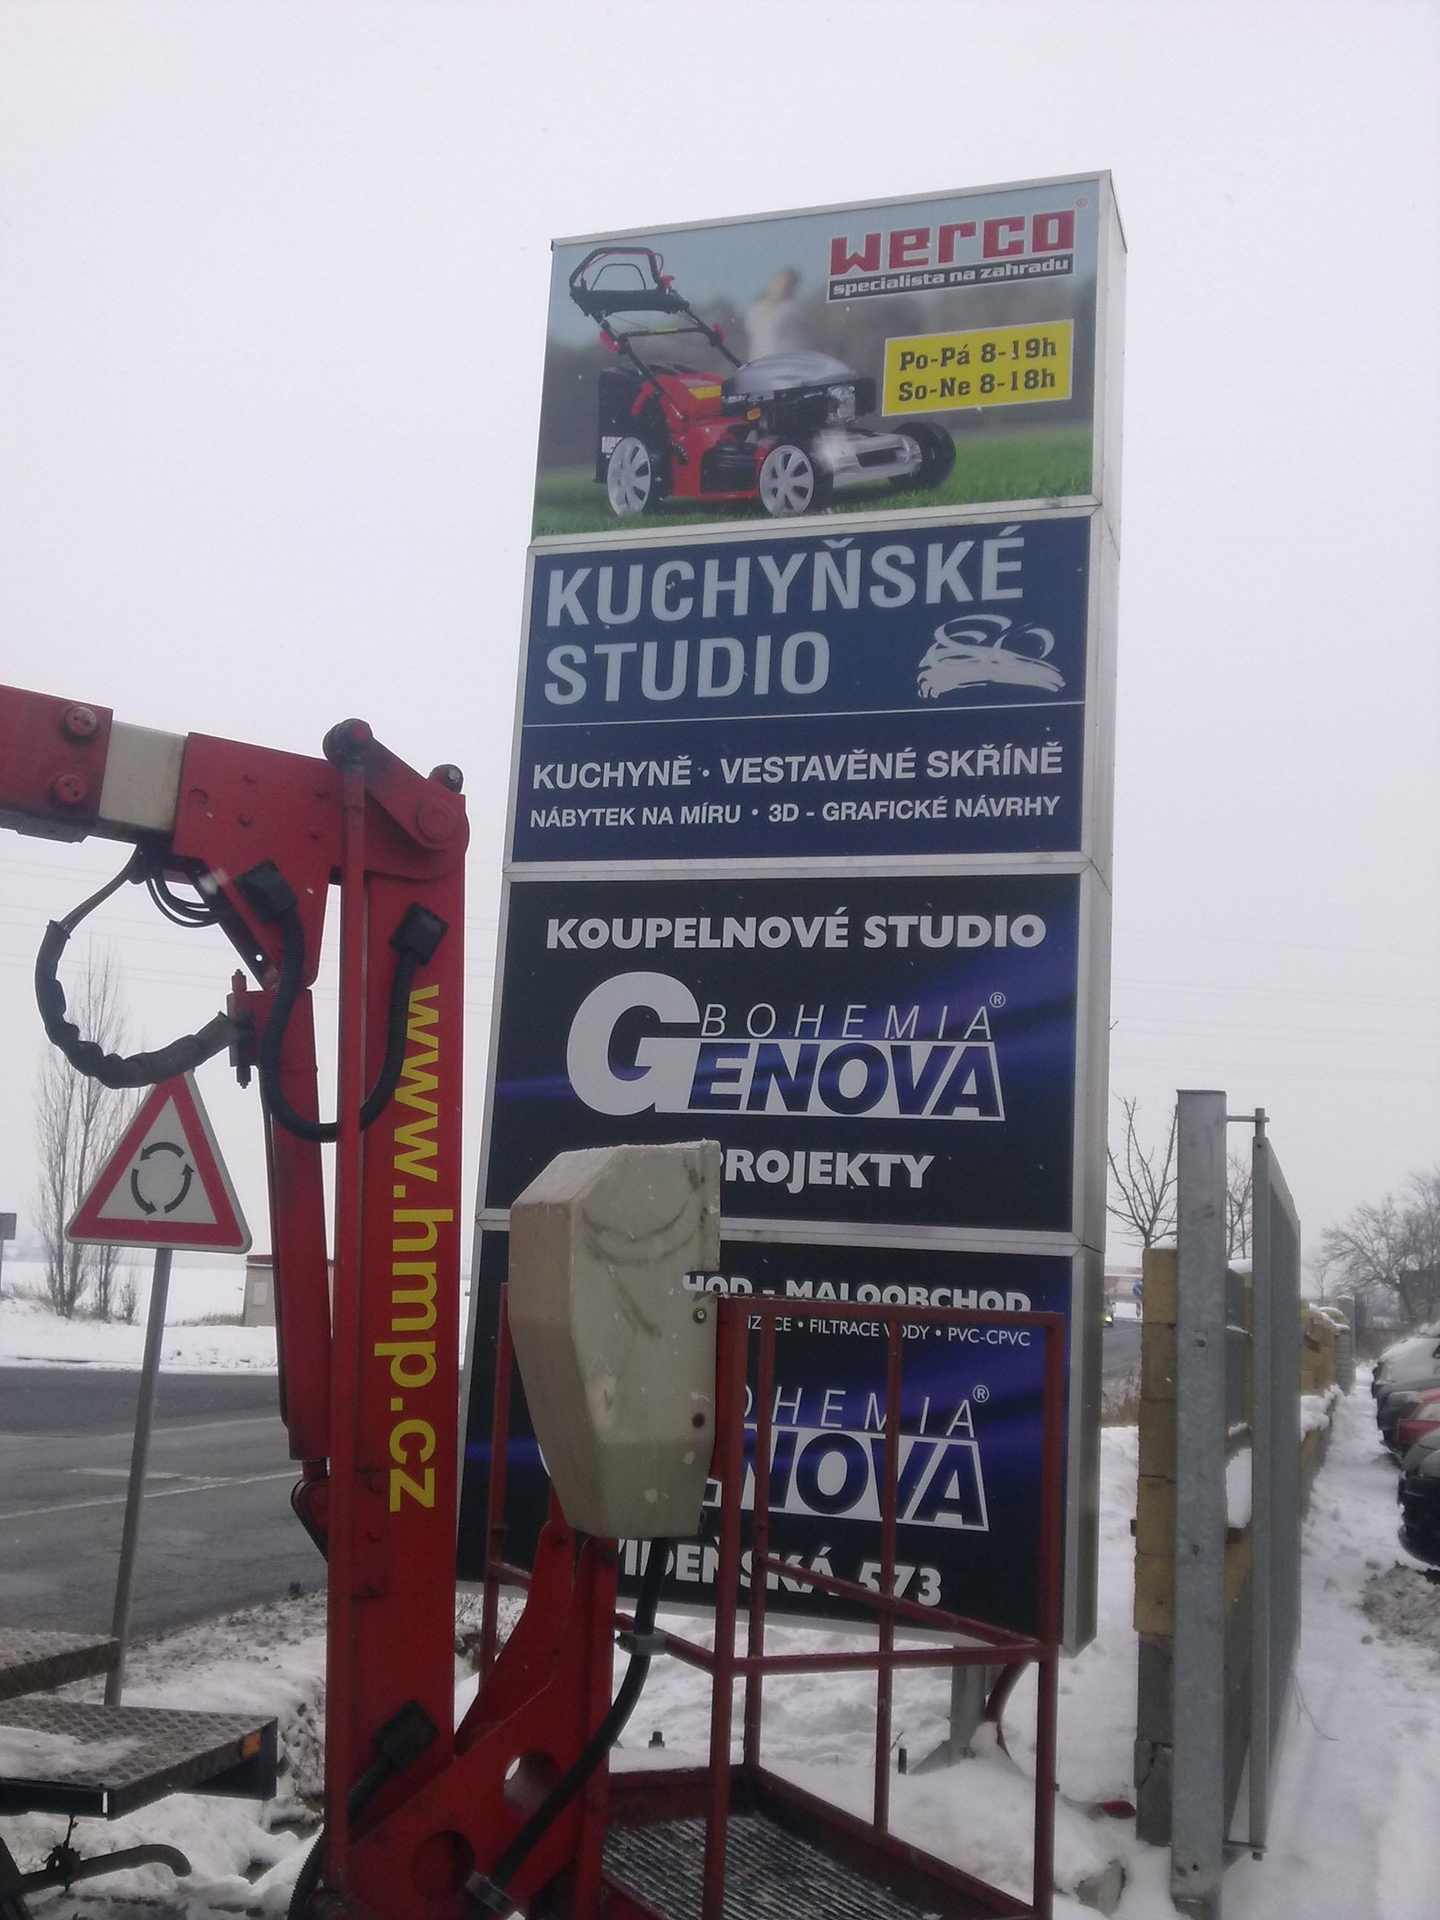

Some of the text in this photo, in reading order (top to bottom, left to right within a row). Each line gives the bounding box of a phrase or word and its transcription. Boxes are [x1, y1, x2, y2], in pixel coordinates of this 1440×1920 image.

[830, 209, 1075, 276] werco
[833, 257, 1069, 297] specialista na zahradu
[899, 337, 1057, 371] Po-Pá 8-19h
[898, 368, 1056, 402] So-Ne 8-18h
[546, 525, 1025, 628] KUCHYŇSKÉ
[544, 631, 831, 705] STUDIO
[533, 741, 1063, 790] KUCHYNĚ VESTAVĚNÉ SKŘÍNĚ
[530, 794, 1061, 828] NÁBYTEK NA MÍRU 3D GRAFICKÉ NÁVRHY
[546, 906, 1047, 949] KOUPELNOVÉ STUDIO
[701, 1002, 993, 1041] BOHEMIA
[566, 971, 1005, 1121] GENOVA
[720, 1148, 935, 1194] ROJEKTY
[374, 984, 454, 1512] www.hmp.cz
[809, 1317, 880, 1338] FILTRACE
[948, 1327, 1031, 1347] PVC-CPVC
[743, 1384, 976, 1438] HEMIA
